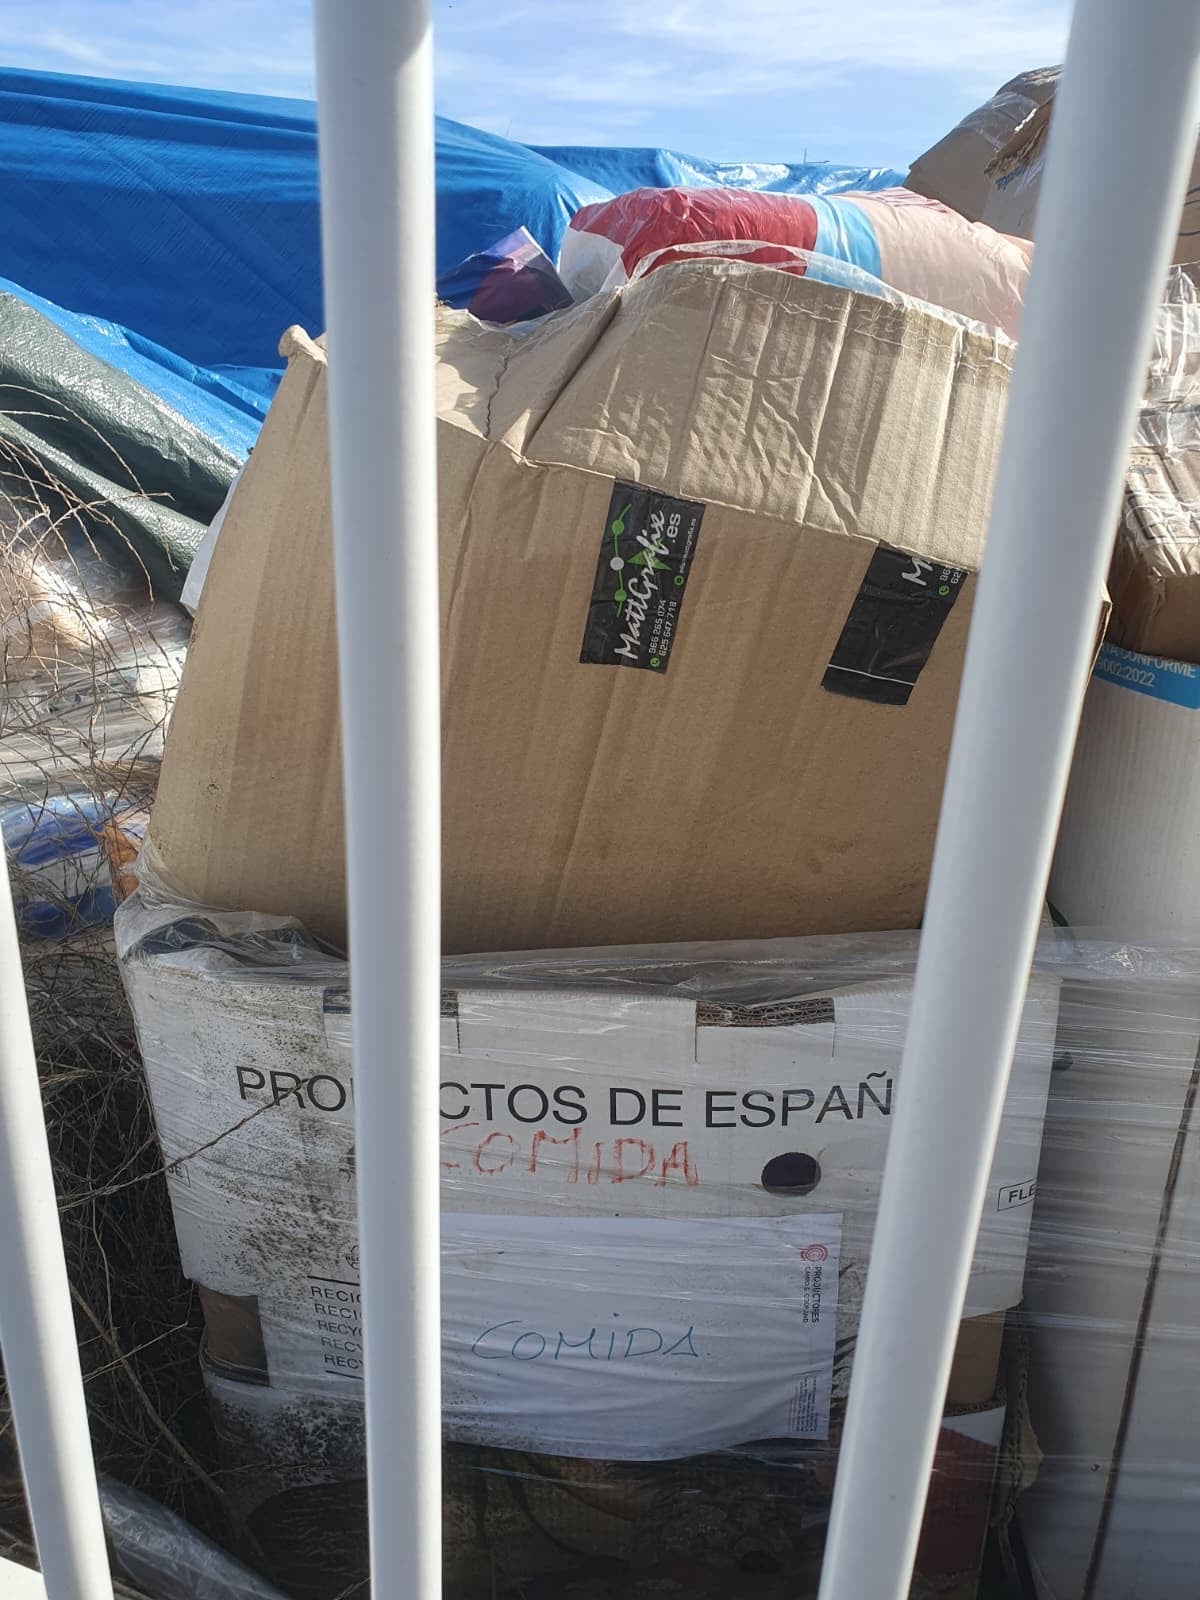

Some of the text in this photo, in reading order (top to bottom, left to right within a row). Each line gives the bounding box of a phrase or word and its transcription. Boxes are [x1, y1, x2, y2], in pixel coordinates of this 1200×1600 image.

[236, 1064, 893, 1129] PROCTOS DE ESPAÑ
[1008, 1183, 1036, 1203] FLE
[310, 1285, 361, 1304] RECI
[314, 1302, 362, 1321] RECI
[318, 1319, 363, 1337] RECY
